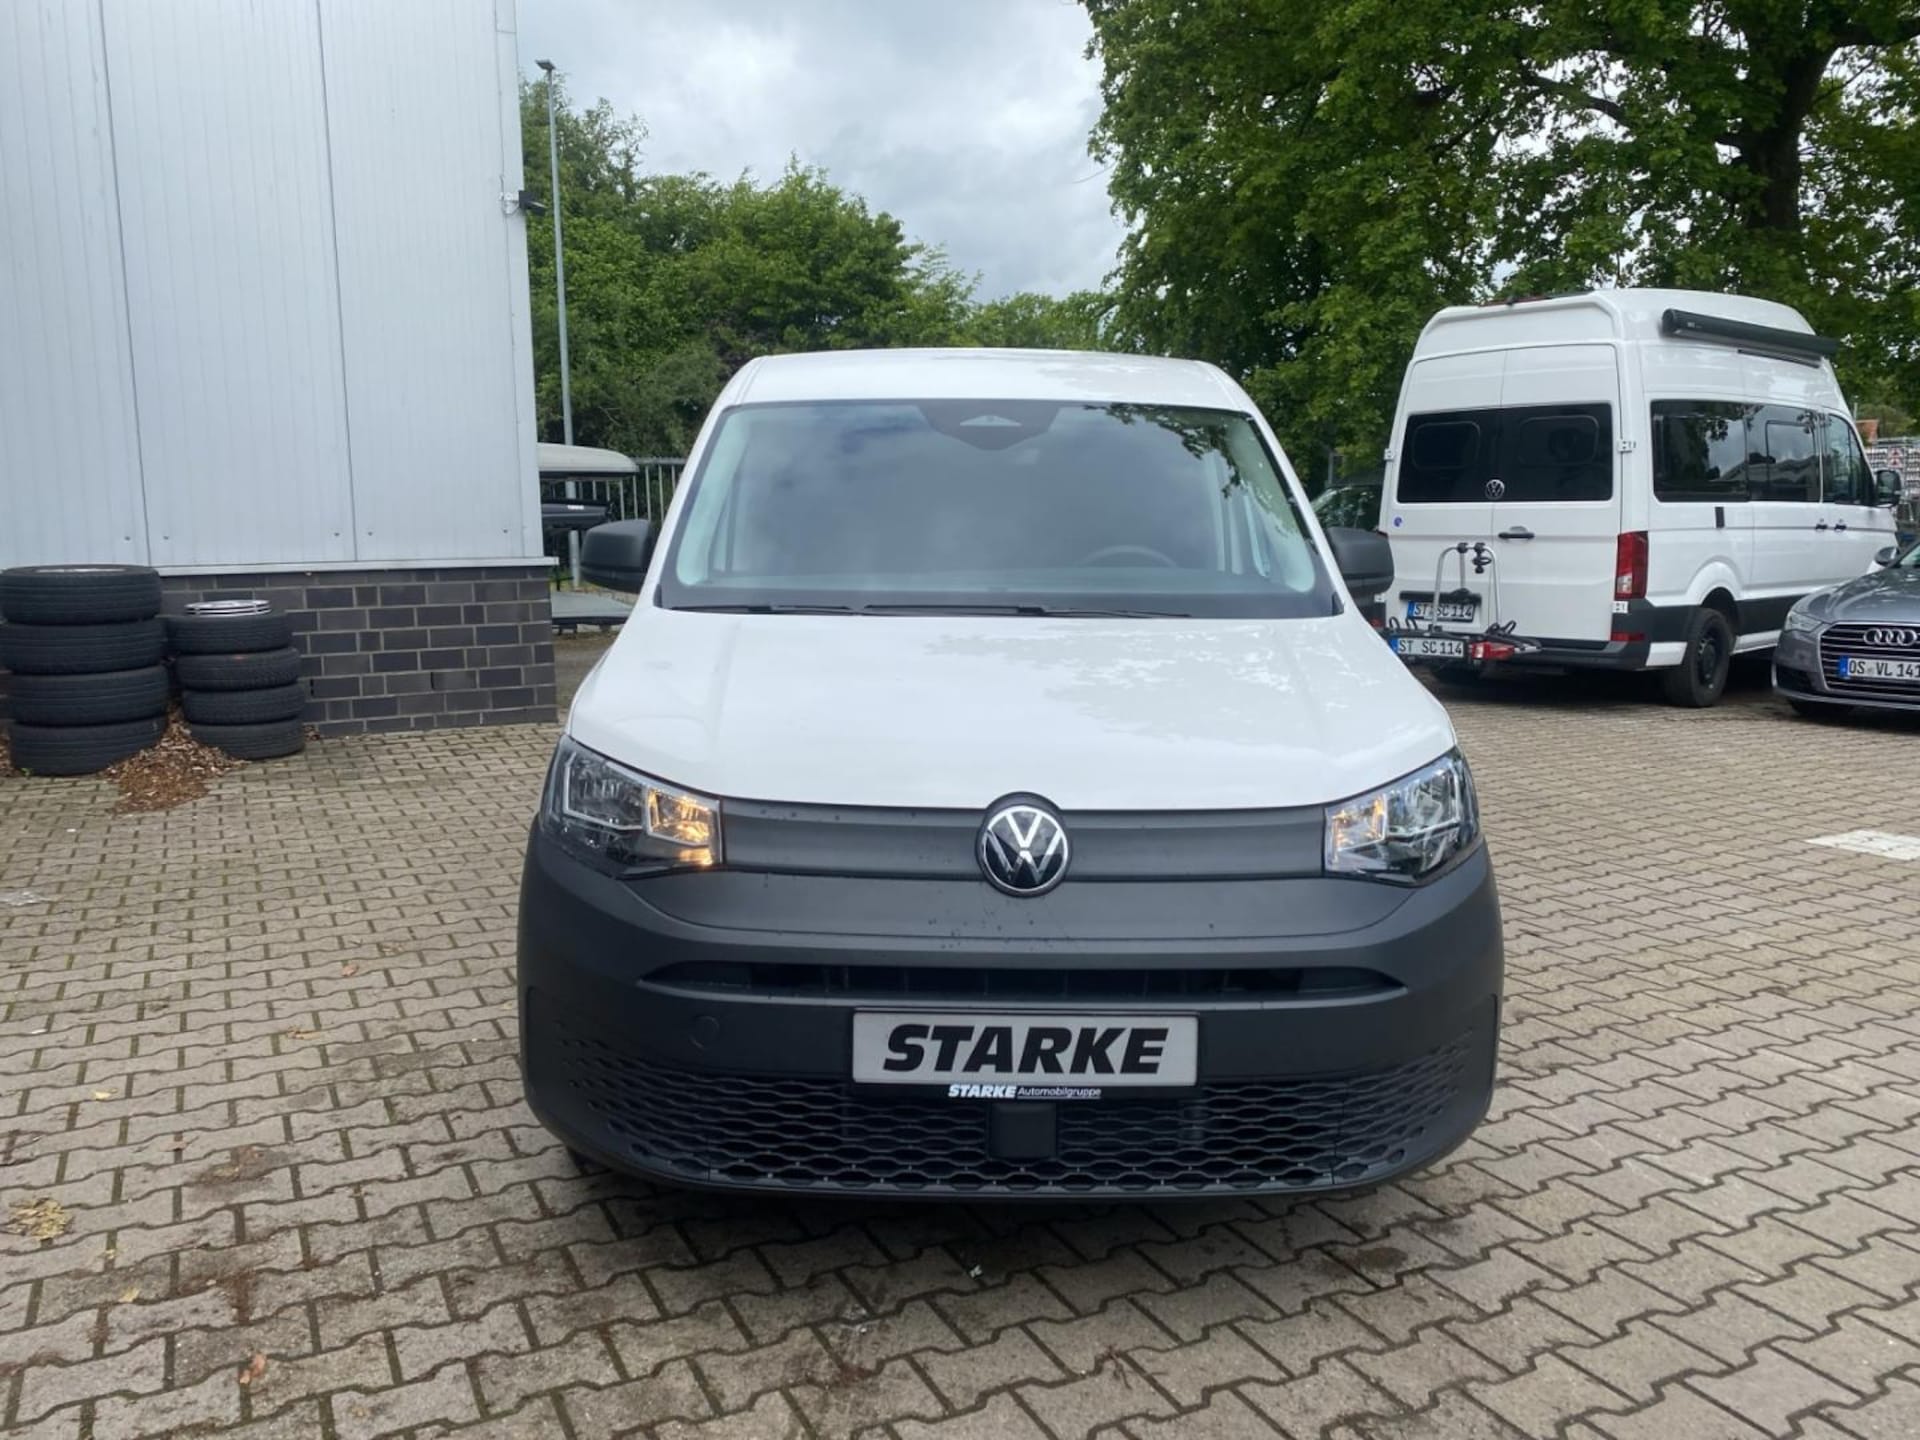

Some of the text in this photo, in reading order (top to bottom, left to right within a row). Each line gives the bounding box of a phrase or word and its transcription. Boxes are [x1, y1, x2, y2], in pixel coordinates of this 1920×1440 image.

[1451, 605, 1472, 618] 114
[1399, 640, 1462, 655] ST SC 114
[1849, 660, 1866, 674] OS
[1876, 662, 1892, 676] VL
[883, 1024, 1169, 1074] STARKE
[948, 1084, 1101, 1099] STARKE Automobilgruppe
